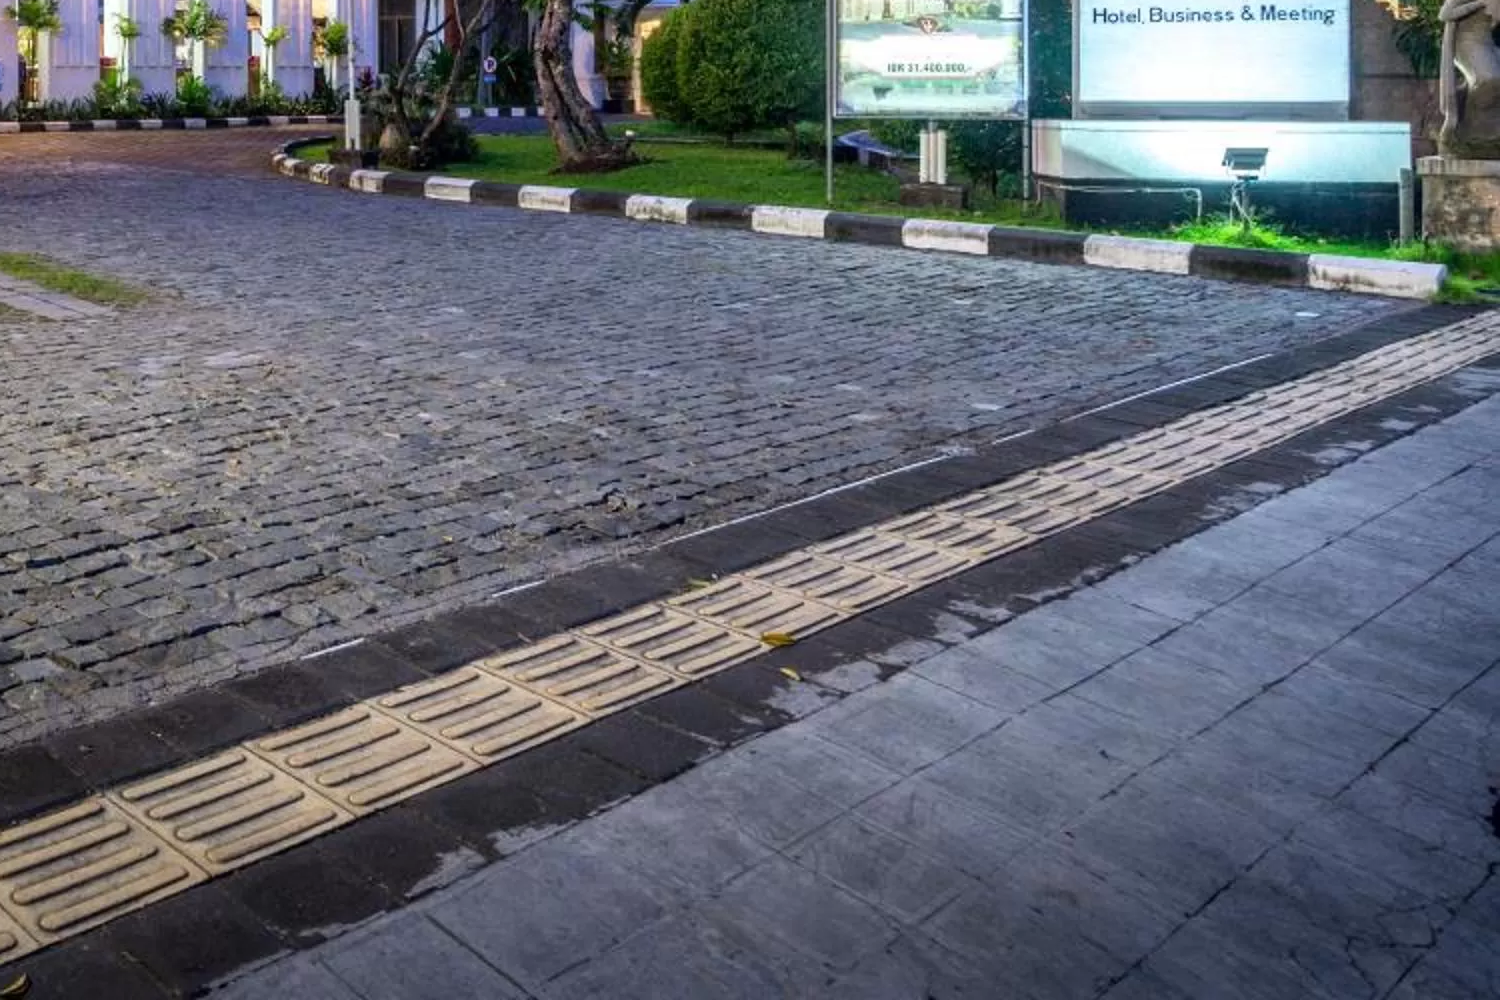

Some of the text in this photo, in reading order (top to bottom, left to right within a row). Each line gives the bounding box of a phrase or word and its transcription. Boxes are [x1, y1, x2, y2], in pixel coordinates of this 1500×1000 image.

[1149, 7, 1234, 22] Business
[1241, 5, 1255, 20] &
[1260, 4, 1335, 25] Meeting
